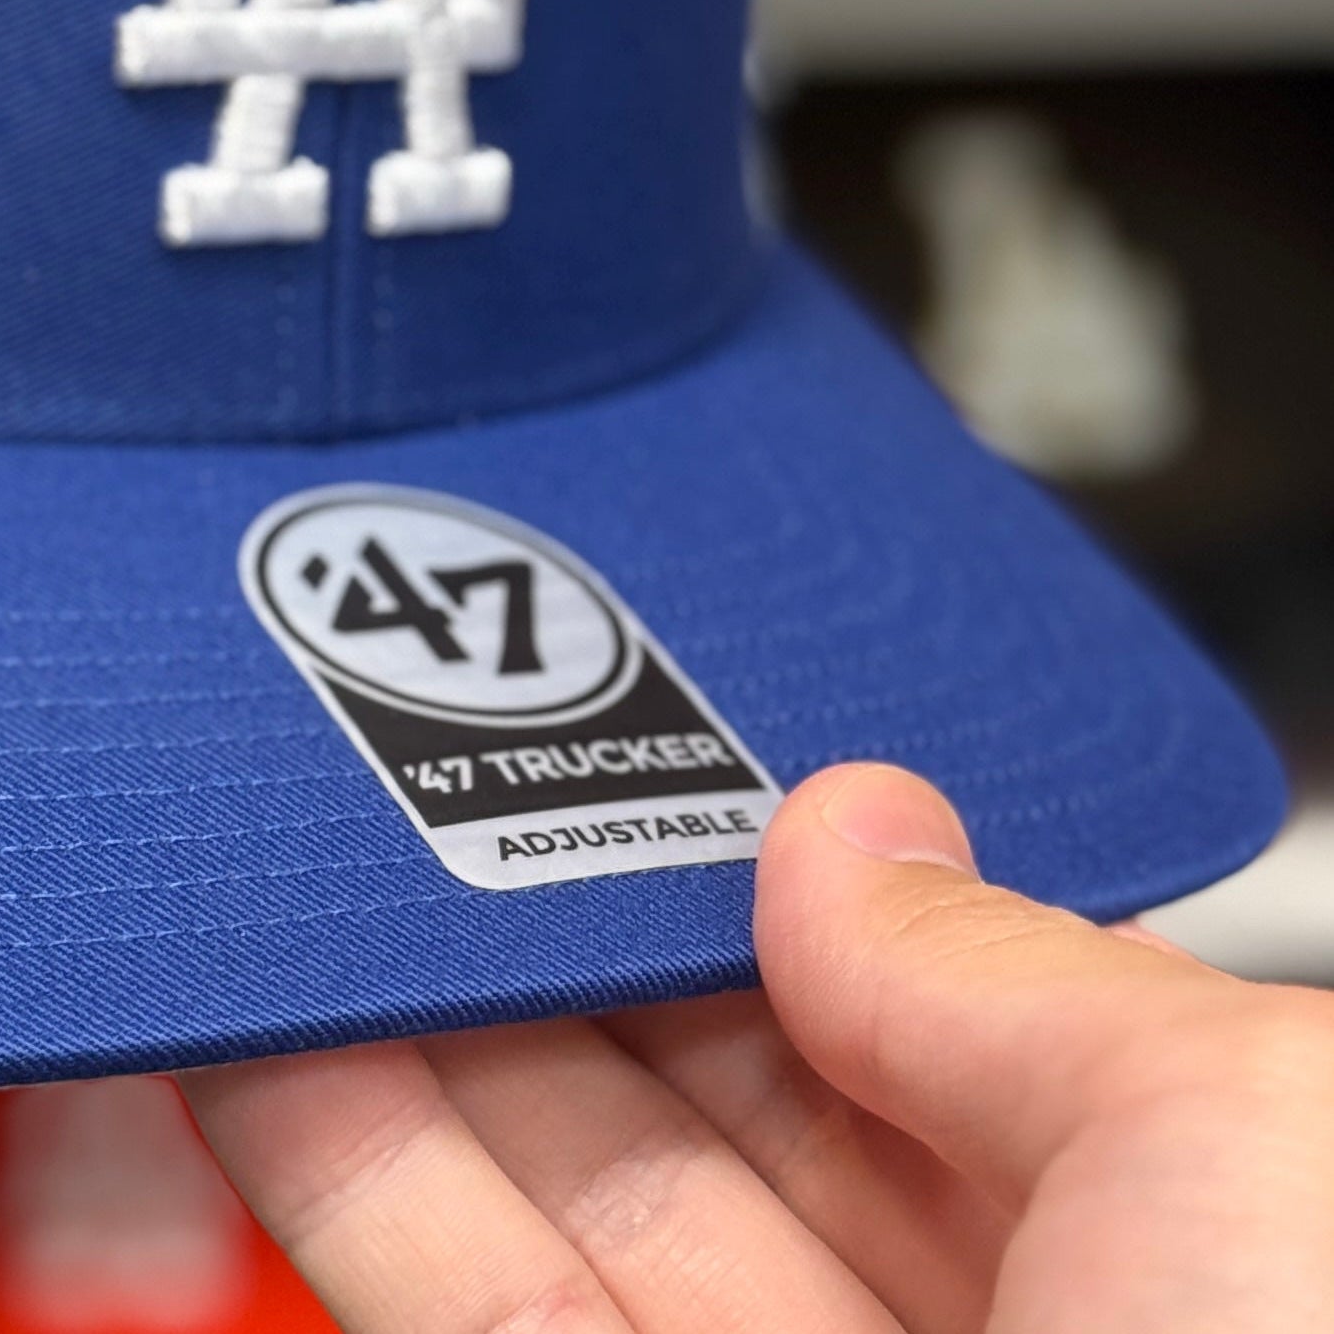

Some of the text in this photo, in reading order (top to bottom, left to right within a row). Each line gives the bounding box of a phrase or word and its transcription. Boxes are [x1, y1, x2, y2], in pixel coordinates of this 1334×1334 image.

[300, 533, 545, 677] '47
[403, 733, 733, 795] '47 TRUCKER
[497, 809, 760, 861] ADJUSTABLE
